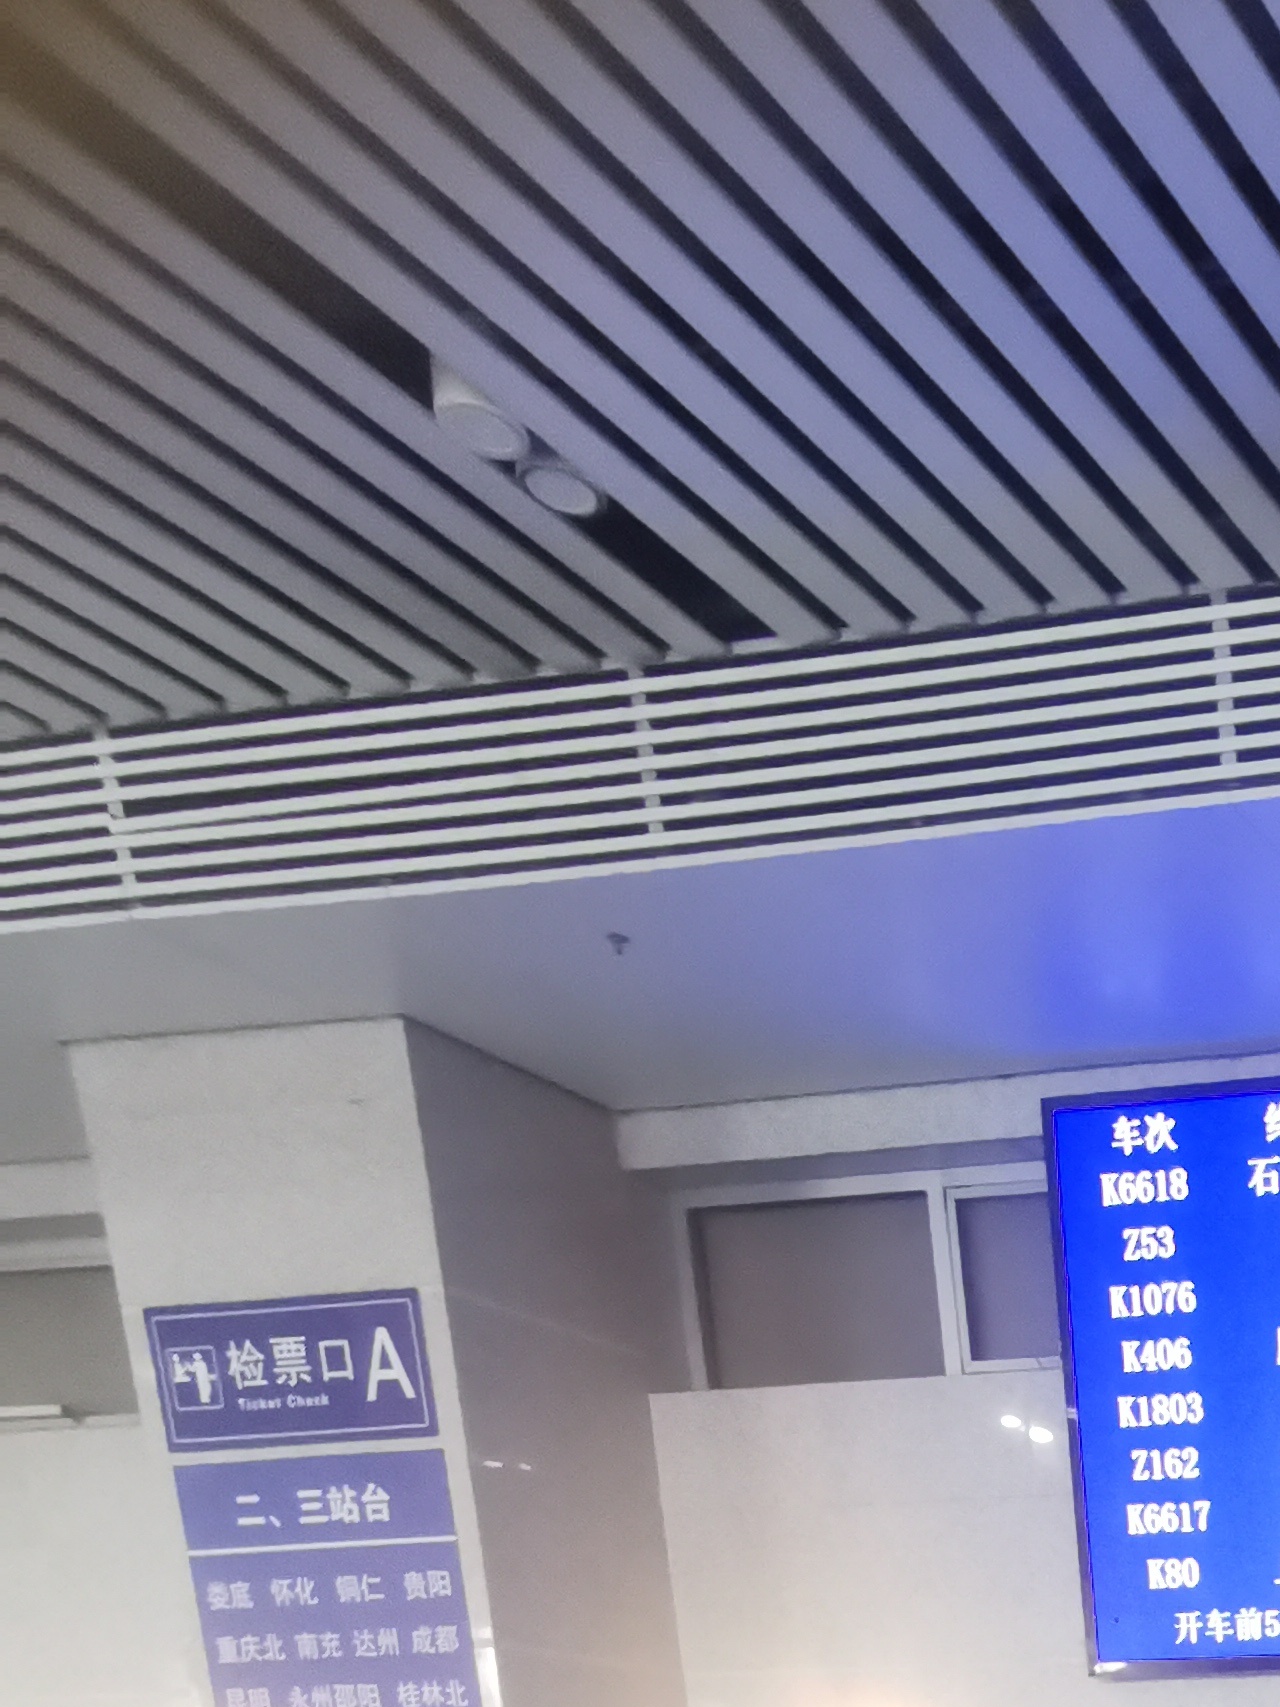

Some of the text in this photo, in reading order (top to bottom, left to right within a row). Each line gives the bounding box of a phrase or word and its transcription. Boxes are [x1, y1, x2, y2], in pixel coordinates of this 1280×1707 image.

[1112, 1113, 1178, 1155] 车次
[1100, 1168, 1188, 1206] K6618
[1123, 1226, 1175, 1261] Z53
[1109, 1281, 1196, 1318] K1076
[226, 1326, 417, 1402] 检票口 A
[1121, 1336, 1192, 1372] K406
[1117, 1392, 1204, 1428] K1803
[1131, 1447, 1199, 1480] Z162
[235, 1483, 391, 1528] 二、三站台
[1127, 1500, 1210, 1535] K6617
[270, 1576, 319, 1607] 怀化
[335, 1573, 385, 1602] 铜仁
[403, 1570, 452, 1600] 贵阳
[1147, 1558, 1200, 1589] K80
[216, 1625, 459, 1664] 重庆北 南充 达州 成都
